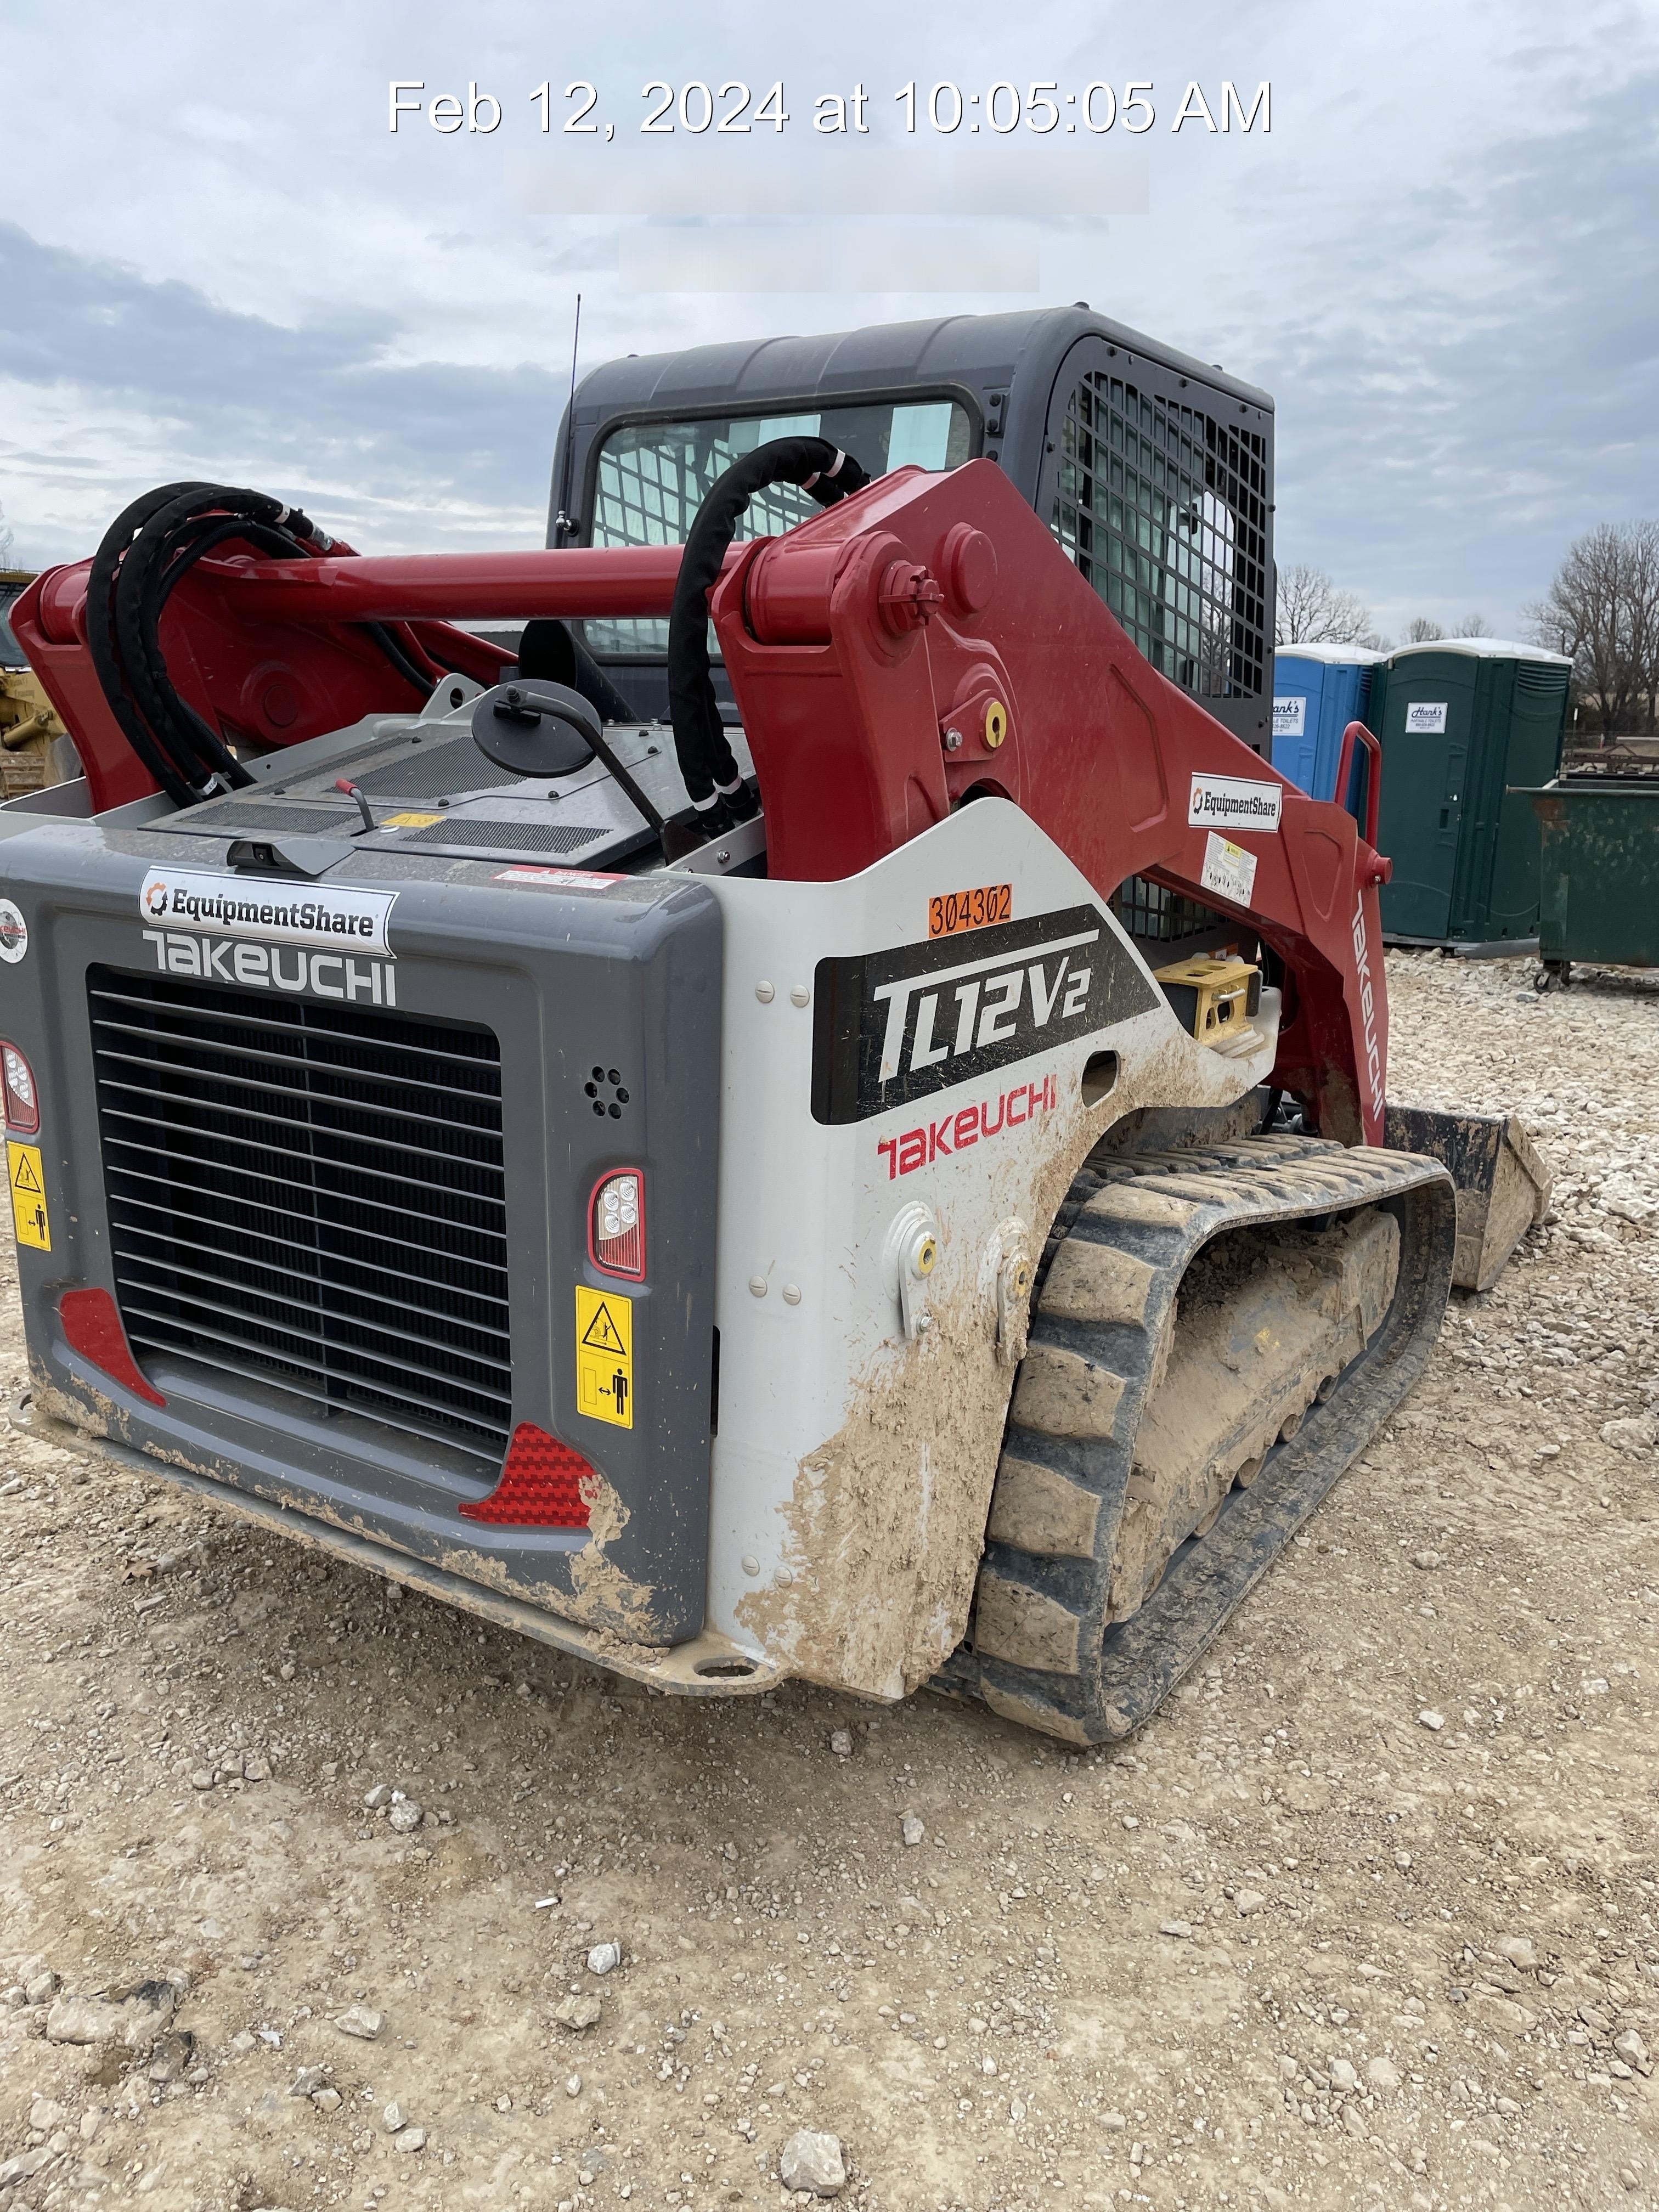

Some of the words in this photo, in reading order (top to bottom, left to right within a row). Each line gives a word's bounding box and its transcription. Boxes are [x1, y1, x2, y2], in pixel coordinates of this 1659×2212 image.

[1273, 701, 1299, 713] ank's
[1412, 706, 1442, 718] Hank's
[1204, 791, 1276, 817] EquipmentShare
[172, 888, 374, 937] EquipmentShare
[930, 884, 1011, 935] 304302
